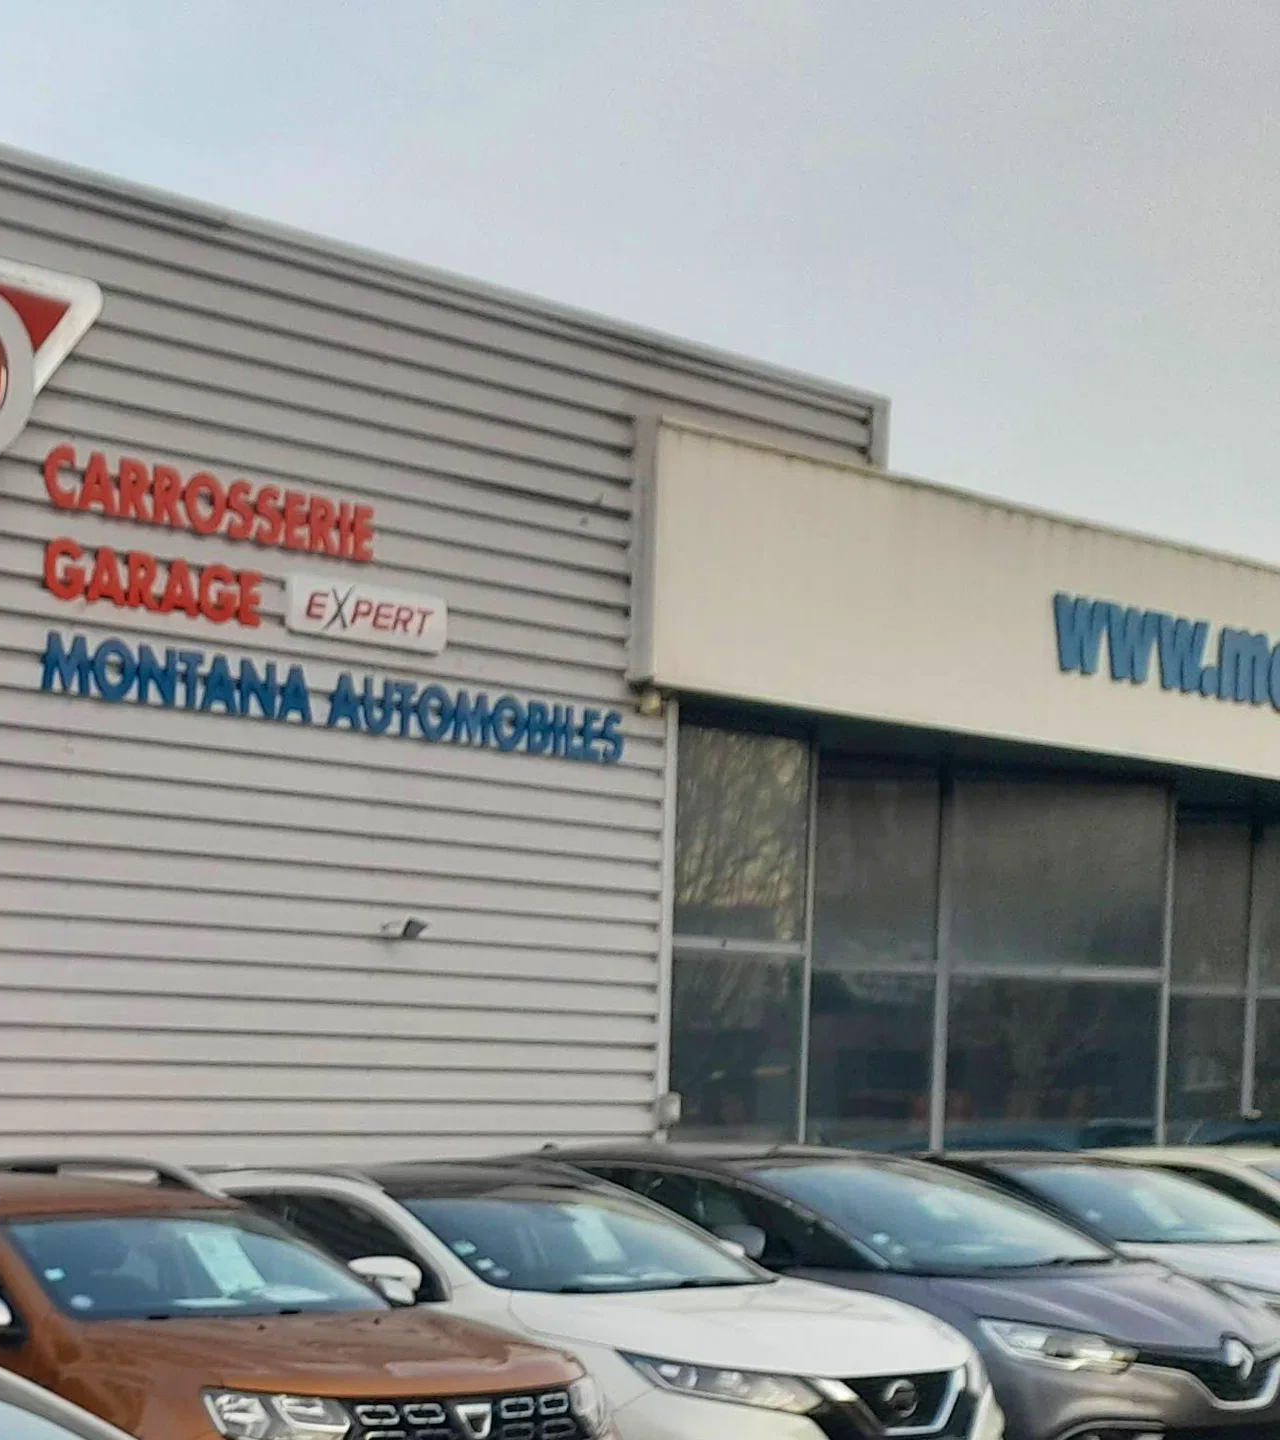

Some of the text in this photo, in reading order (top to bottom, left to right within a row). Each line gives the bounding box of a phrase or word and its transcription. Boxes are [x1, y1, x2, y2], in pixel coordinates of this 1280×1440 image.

[43, 443, 375, 562] CARROSSERIE
[44, 537, 434, 637] GARAGE EXPERT
[40, 631, 624, 765] MONTANA AUTOMOBILES
